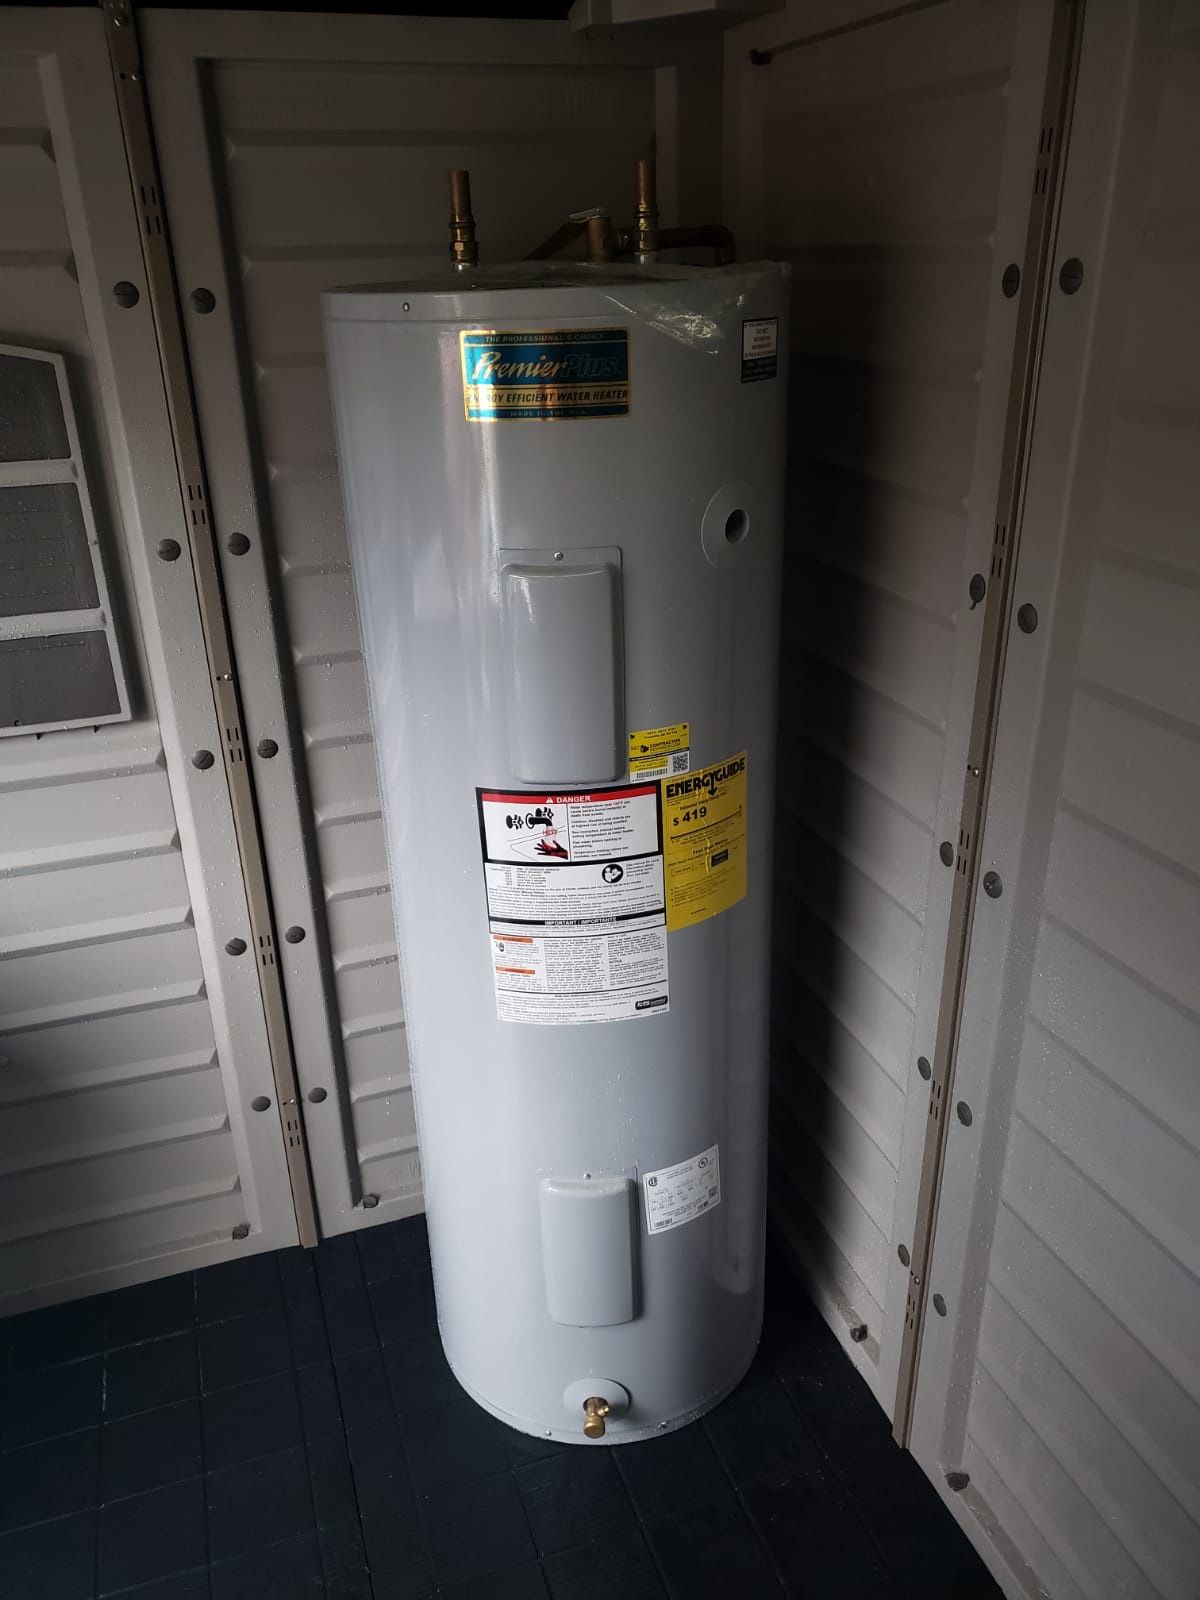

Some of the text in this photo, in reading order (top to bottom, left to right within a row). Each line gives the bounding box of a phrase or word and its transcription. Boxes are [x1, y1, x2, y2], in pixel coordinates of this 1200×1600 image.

[507, 392, 554, 403] EFFICIENT
[557, 391, 591, 401] WATER
[593, 389, 628, 400] HEATER
[666, 756, 745, 798] ENERGYGUIDE
[556, 795, 592, 804] DANGER
[682, 806, 707, 822] 419
